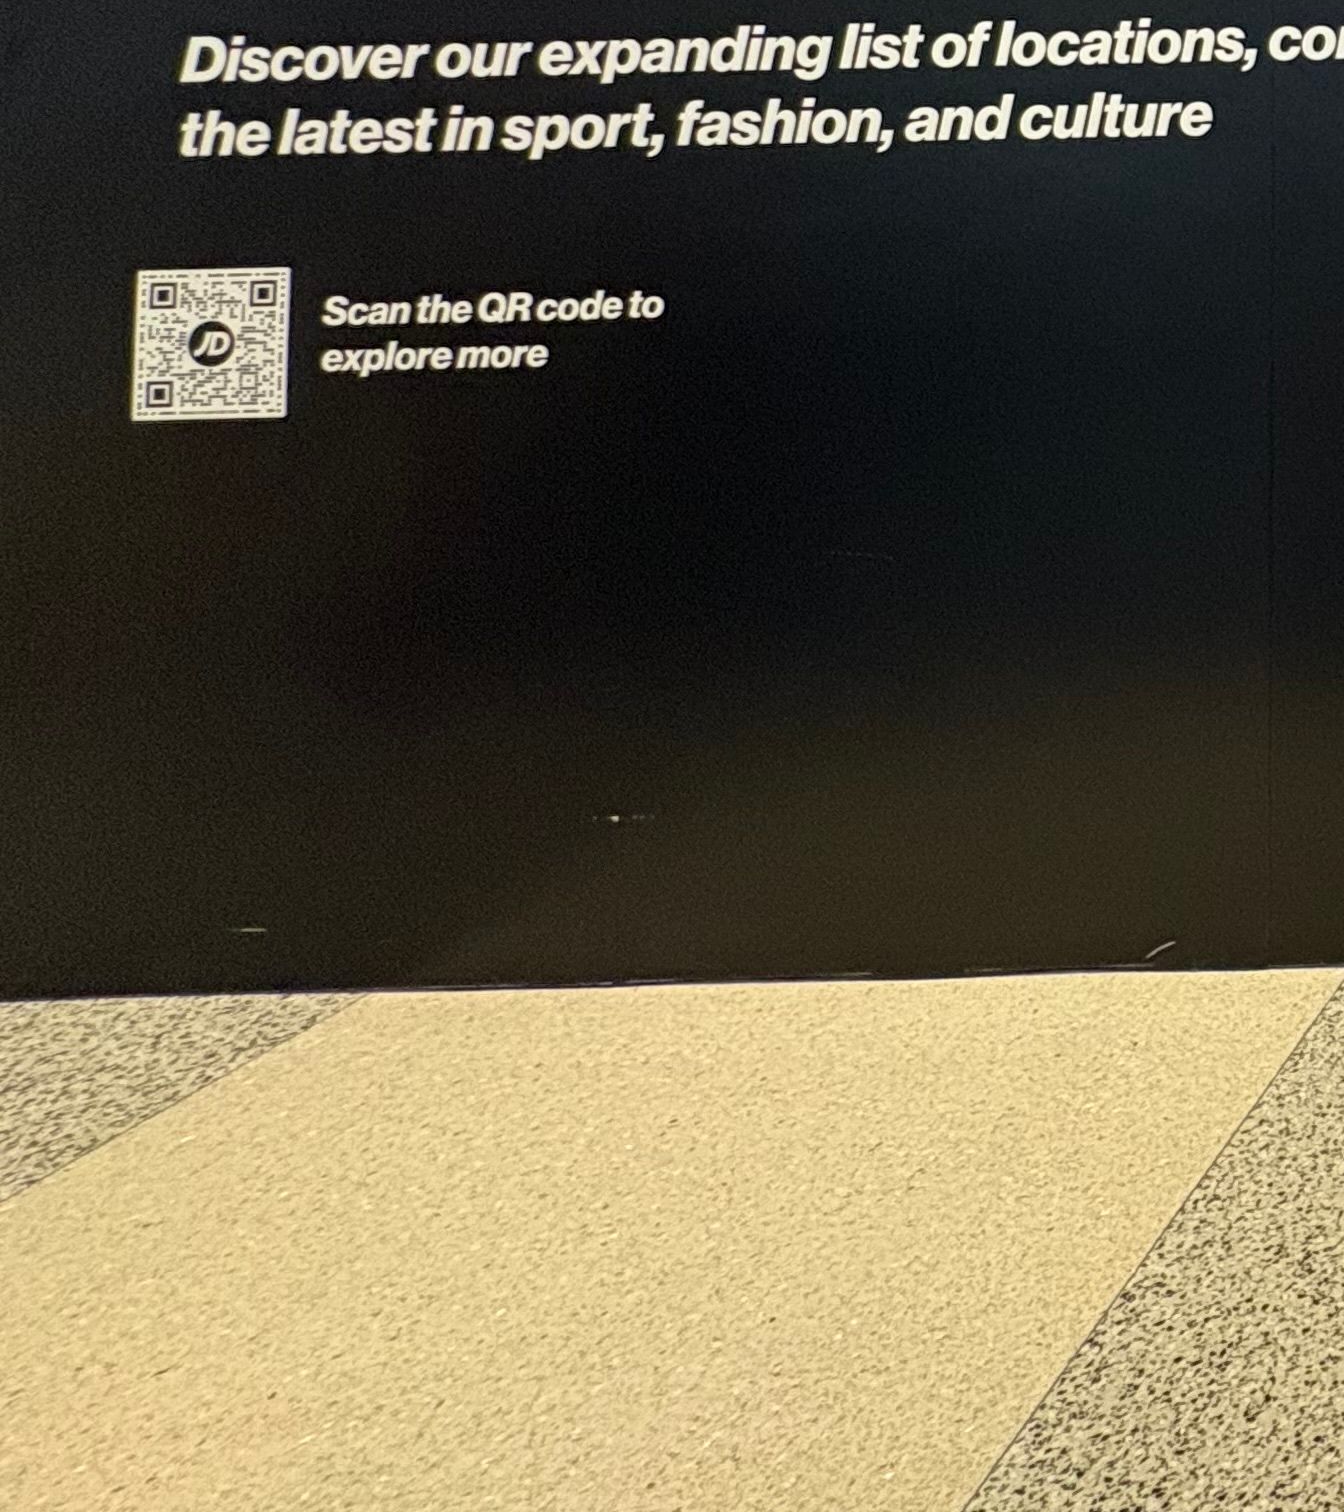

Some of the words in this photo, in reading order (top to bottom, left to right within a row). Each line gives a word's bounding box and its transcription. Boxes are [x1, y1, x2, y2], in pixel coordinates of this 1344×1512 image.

[180, 36, 430, 83] Discover
[435, 41, 533, 78] our
[538, 25, 833, 84] expanding
[839, 22, 925, 70] list
[931, 21, 993, 68] of
[995, 18, 1257, 72] locations,
[180, 110, 271, 157] the
[277, 107, 438, 155] latest
[441, 104, 494, 152] in
[501, 103, 664, 160] sport,
[677, 97, 894, 152] fashion,
[904, 94, 1015, 142] and
[1019, 92, 1213, 140] culture
[321, 295, 411, 326] Scan
[416, 294, 473, 324] the
[478, 292, 533, 324] QR
[536, 290, 623, 322] code
[629, 290, 665, 319] to
[193, 331, 231, 358] JD
[320, 340, 453, 377] explore
[456, 344, 549, 369] more
